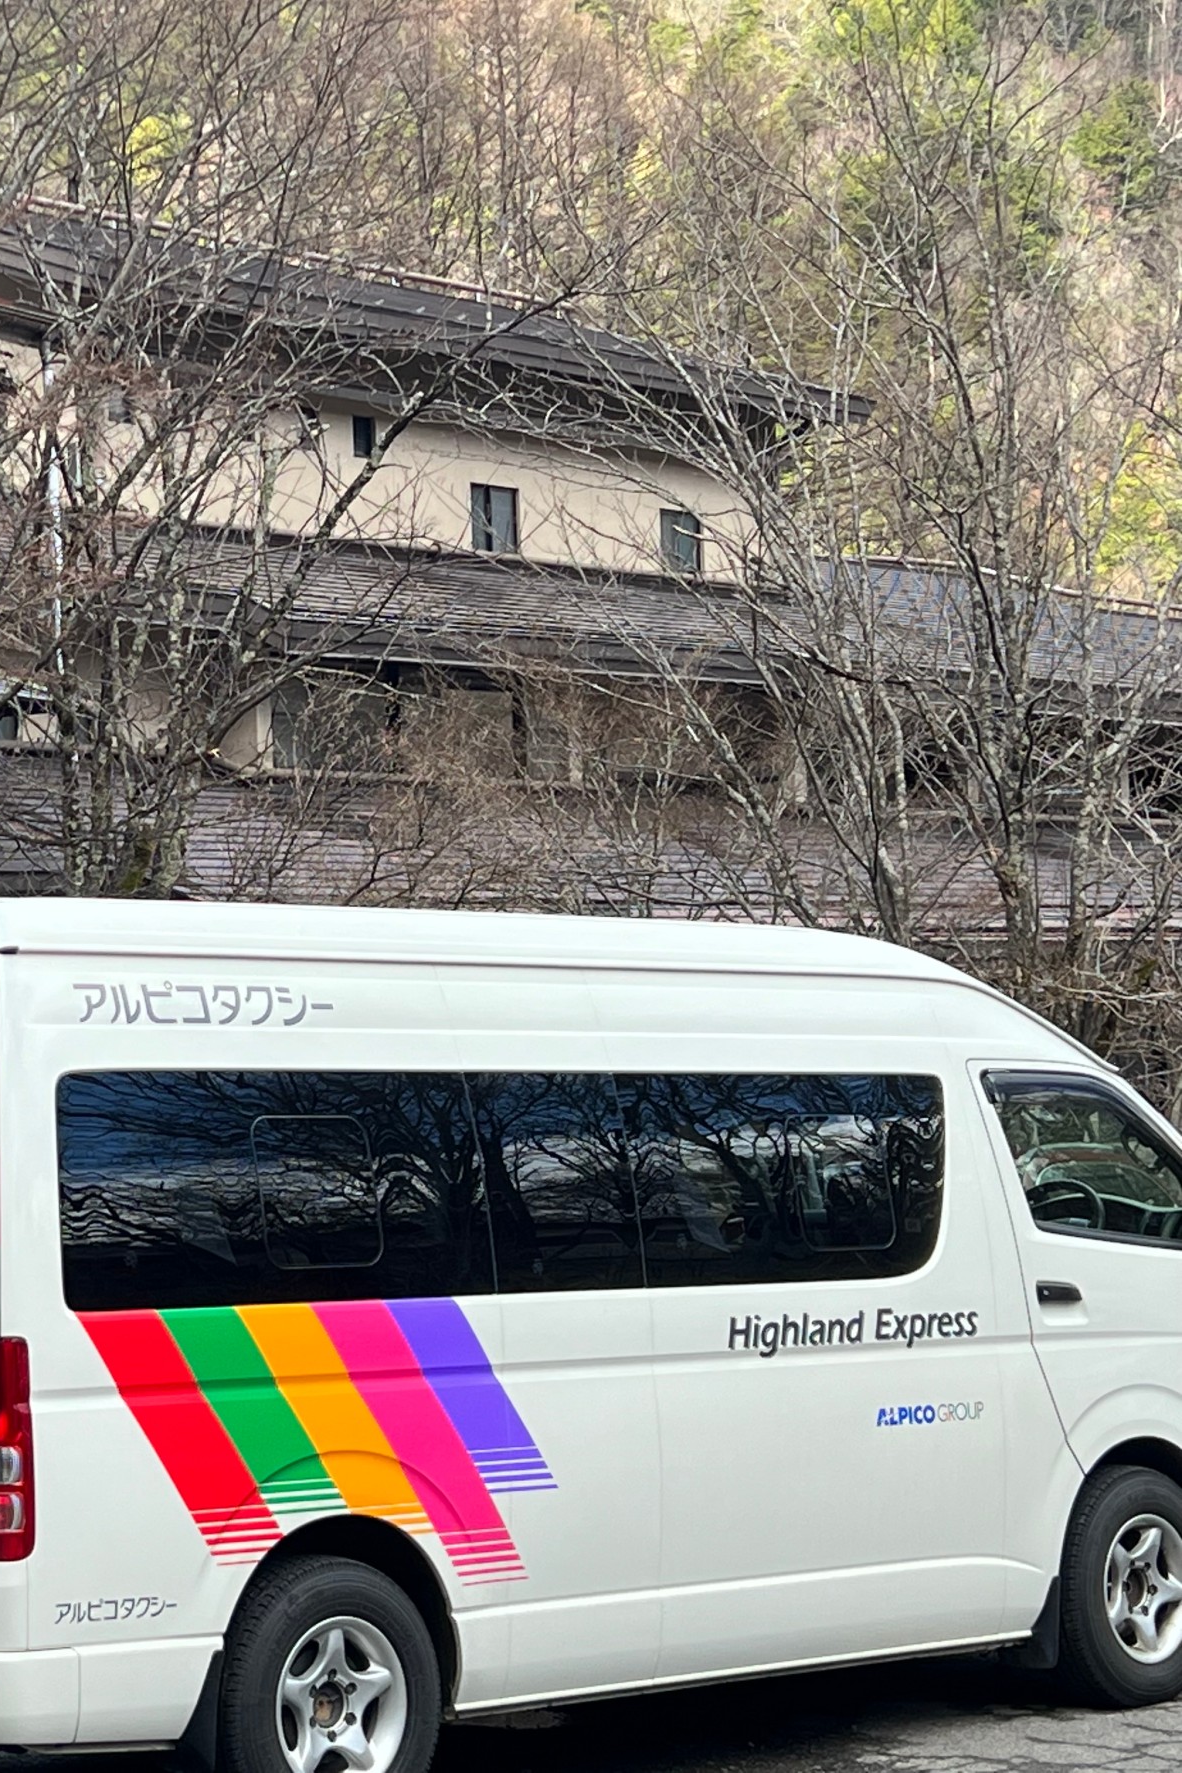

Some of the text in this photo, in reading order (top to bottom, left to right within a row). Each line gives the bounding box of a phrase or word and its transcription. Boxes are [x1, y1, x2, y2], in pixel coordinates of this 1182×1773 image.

[72, 980, 334, 1027] アルピコタクシー
[728, 1308, 979, 1358] Highland Express
[54, 1596, 178, 1625] アルピコタクシー
